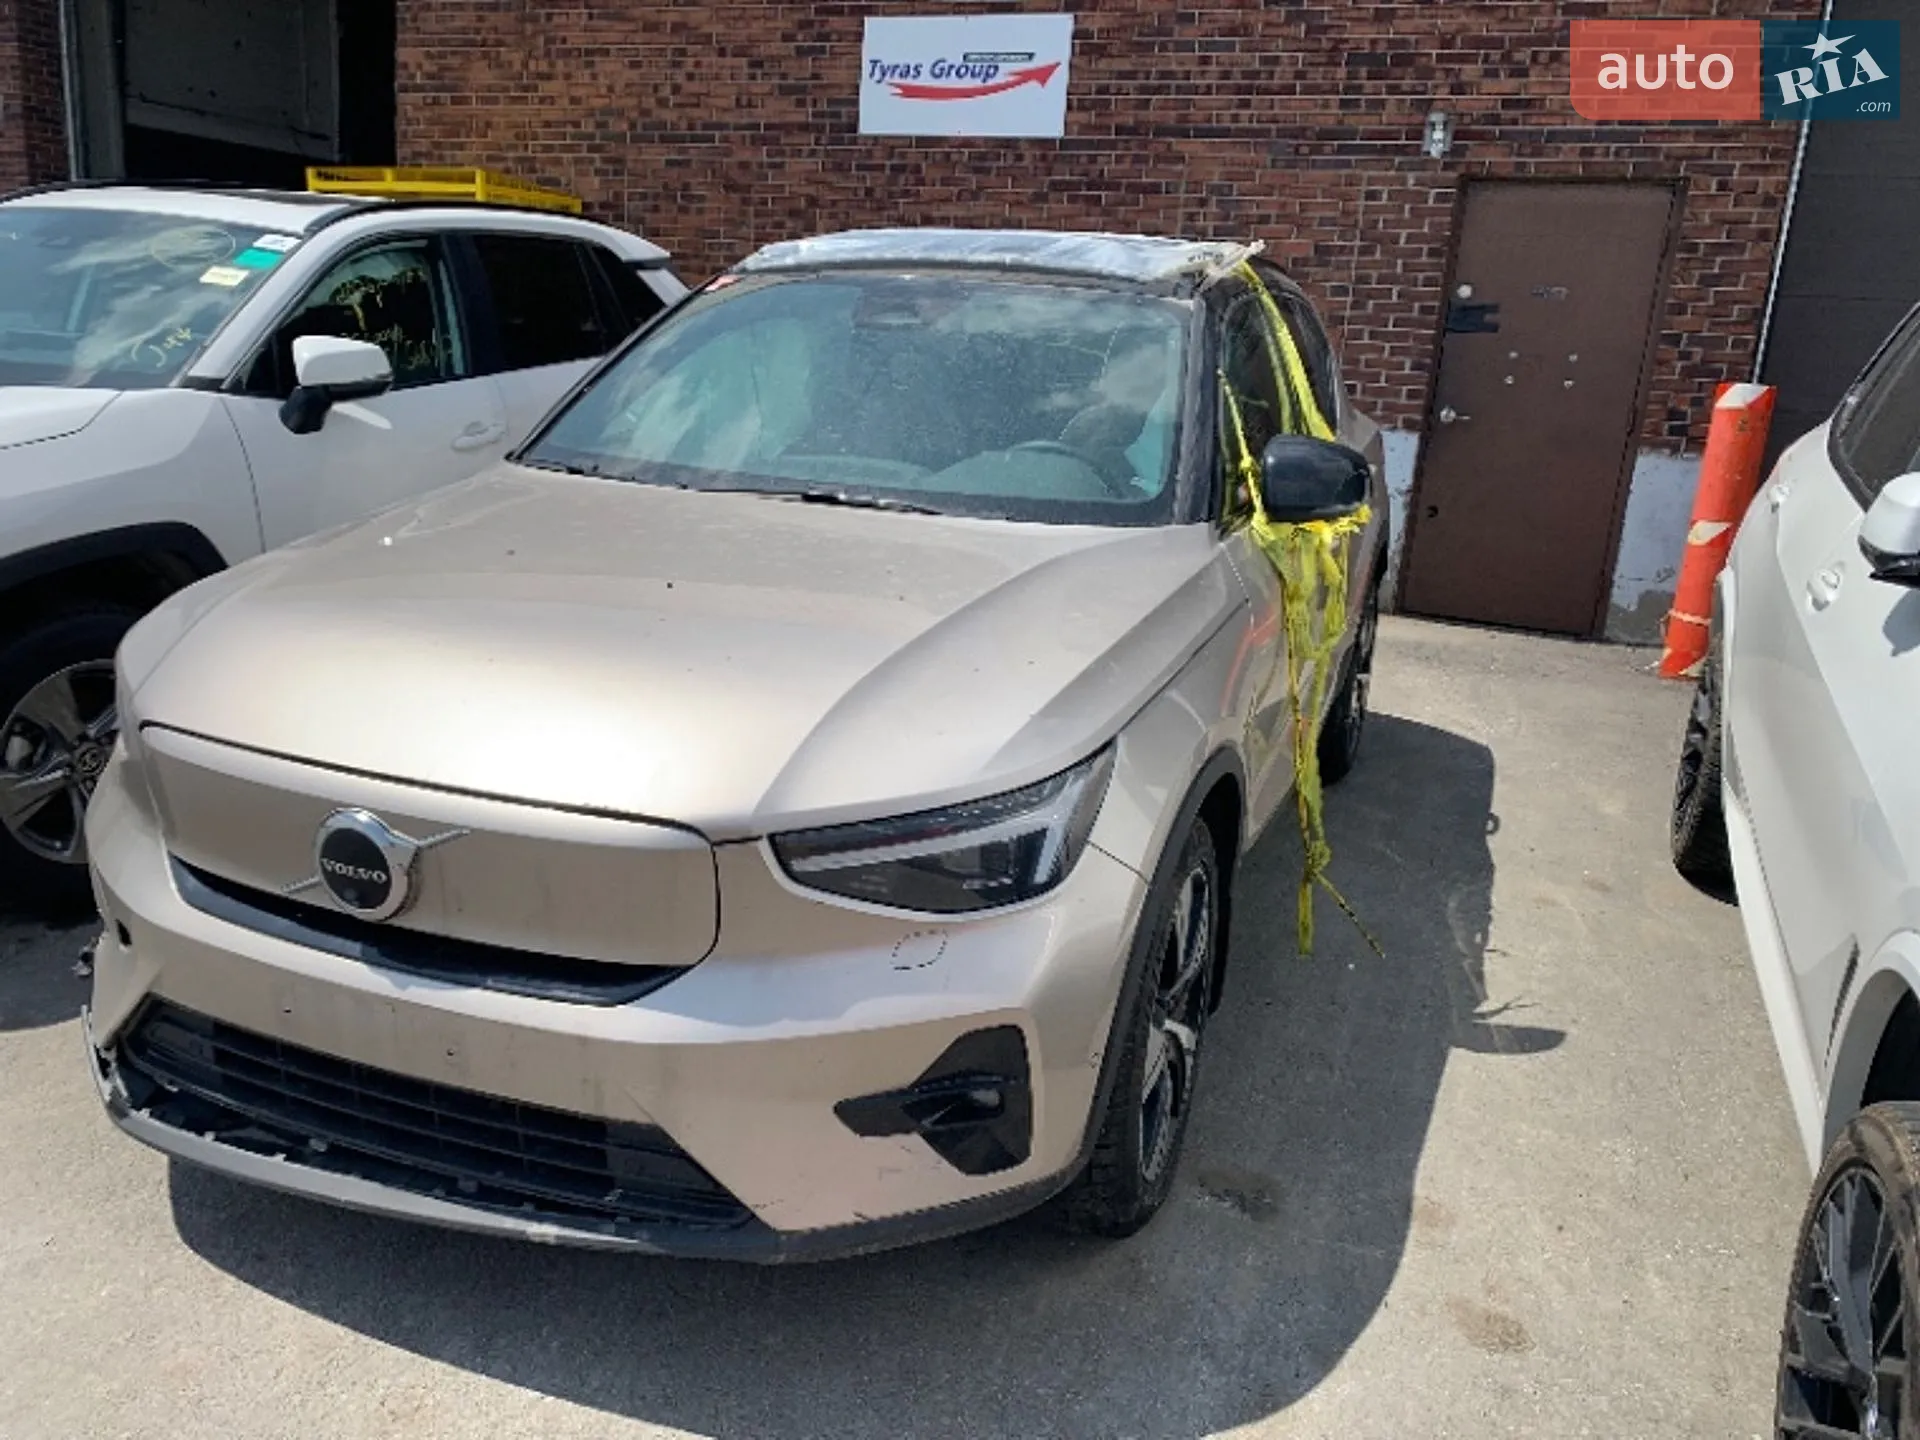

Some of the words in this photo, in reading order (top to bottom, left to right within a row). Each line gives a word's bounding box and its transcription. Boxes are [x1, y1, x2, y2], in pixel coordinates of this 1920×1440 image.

[868, 59, 923, 84] Tyras
[930, 57, 999, 84] Group
[321, 858, 388, 884] VOLVO
